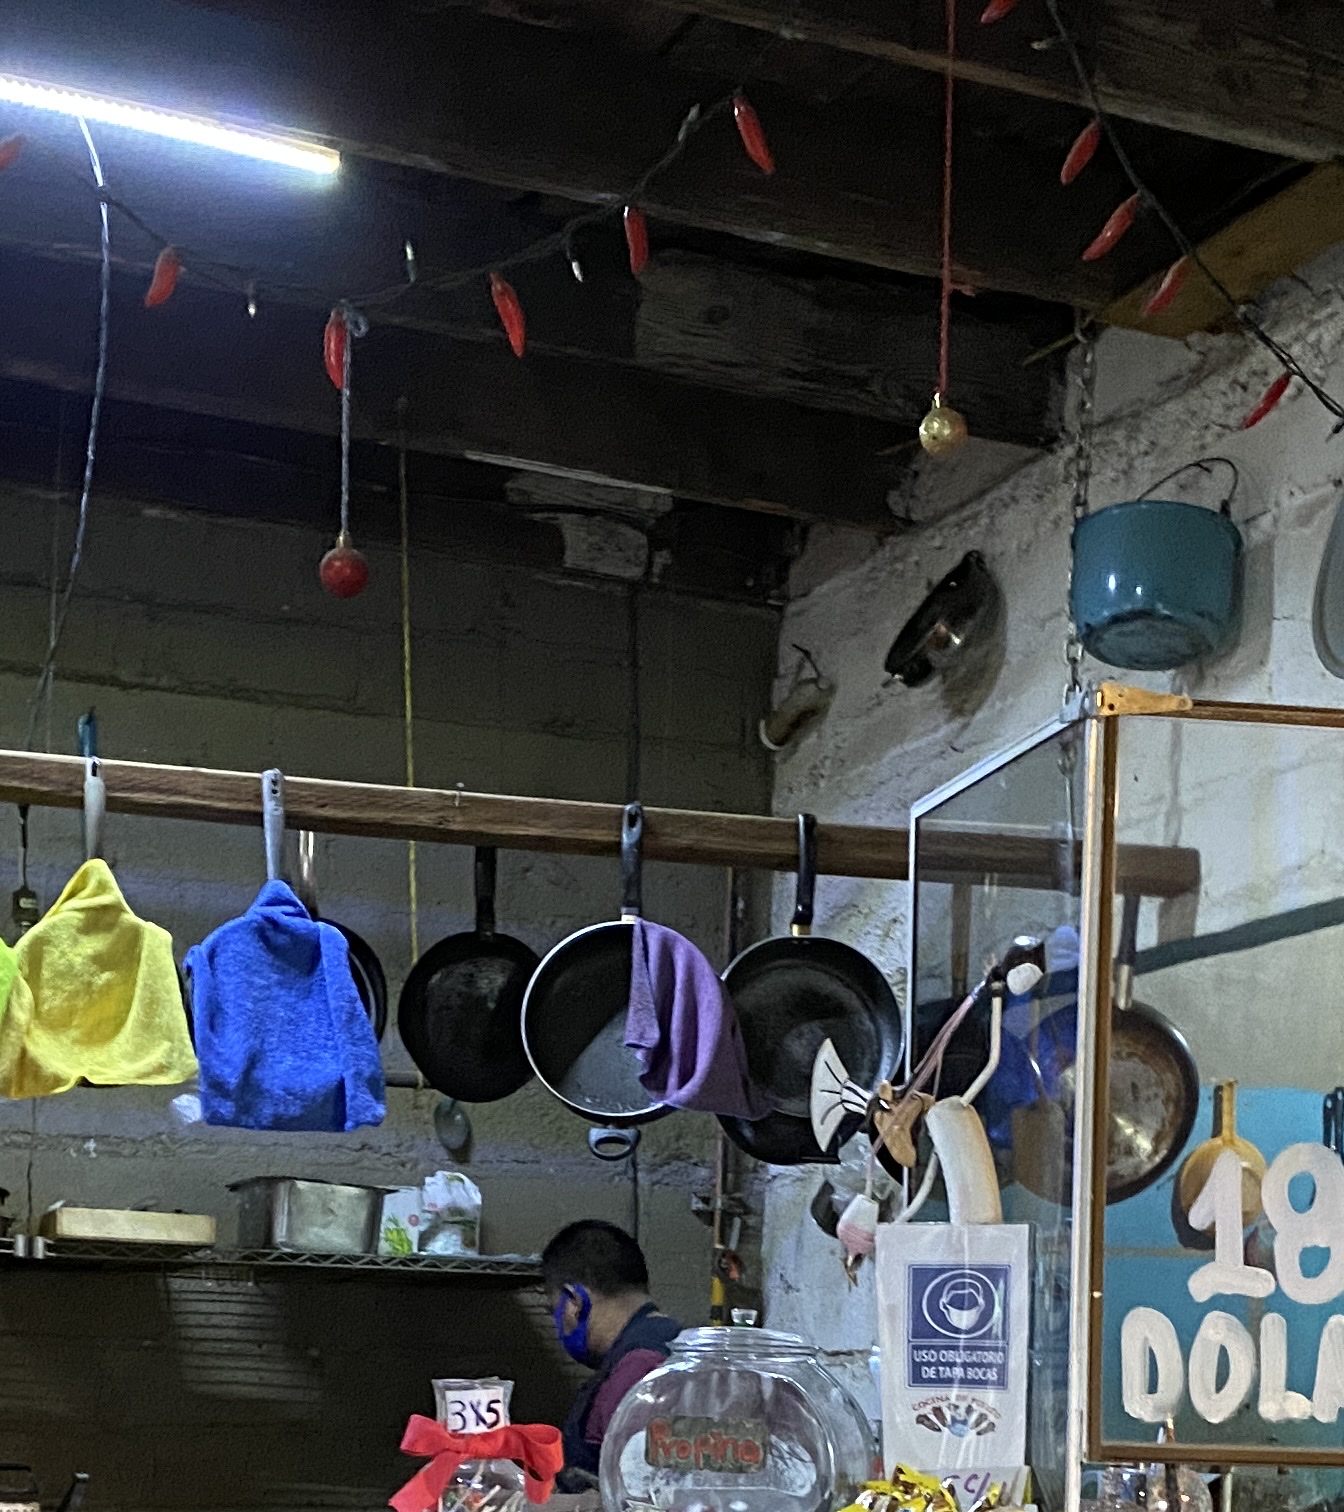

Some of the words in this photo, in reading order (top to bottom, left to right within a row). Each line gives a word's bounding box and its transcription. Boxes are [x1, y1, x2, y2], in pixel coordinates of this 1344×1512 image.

[913, 1350, 937, 1362] USO
[939, 1350, 1004, 1364] OBLIGATORIO
[921, 1366, 937, 1379] DE
[938, 1366, 965, 1379] TAPA
[967, 1367, 998, 1380] BOCAS
[912, 1393, 950, 1411] COCINA
